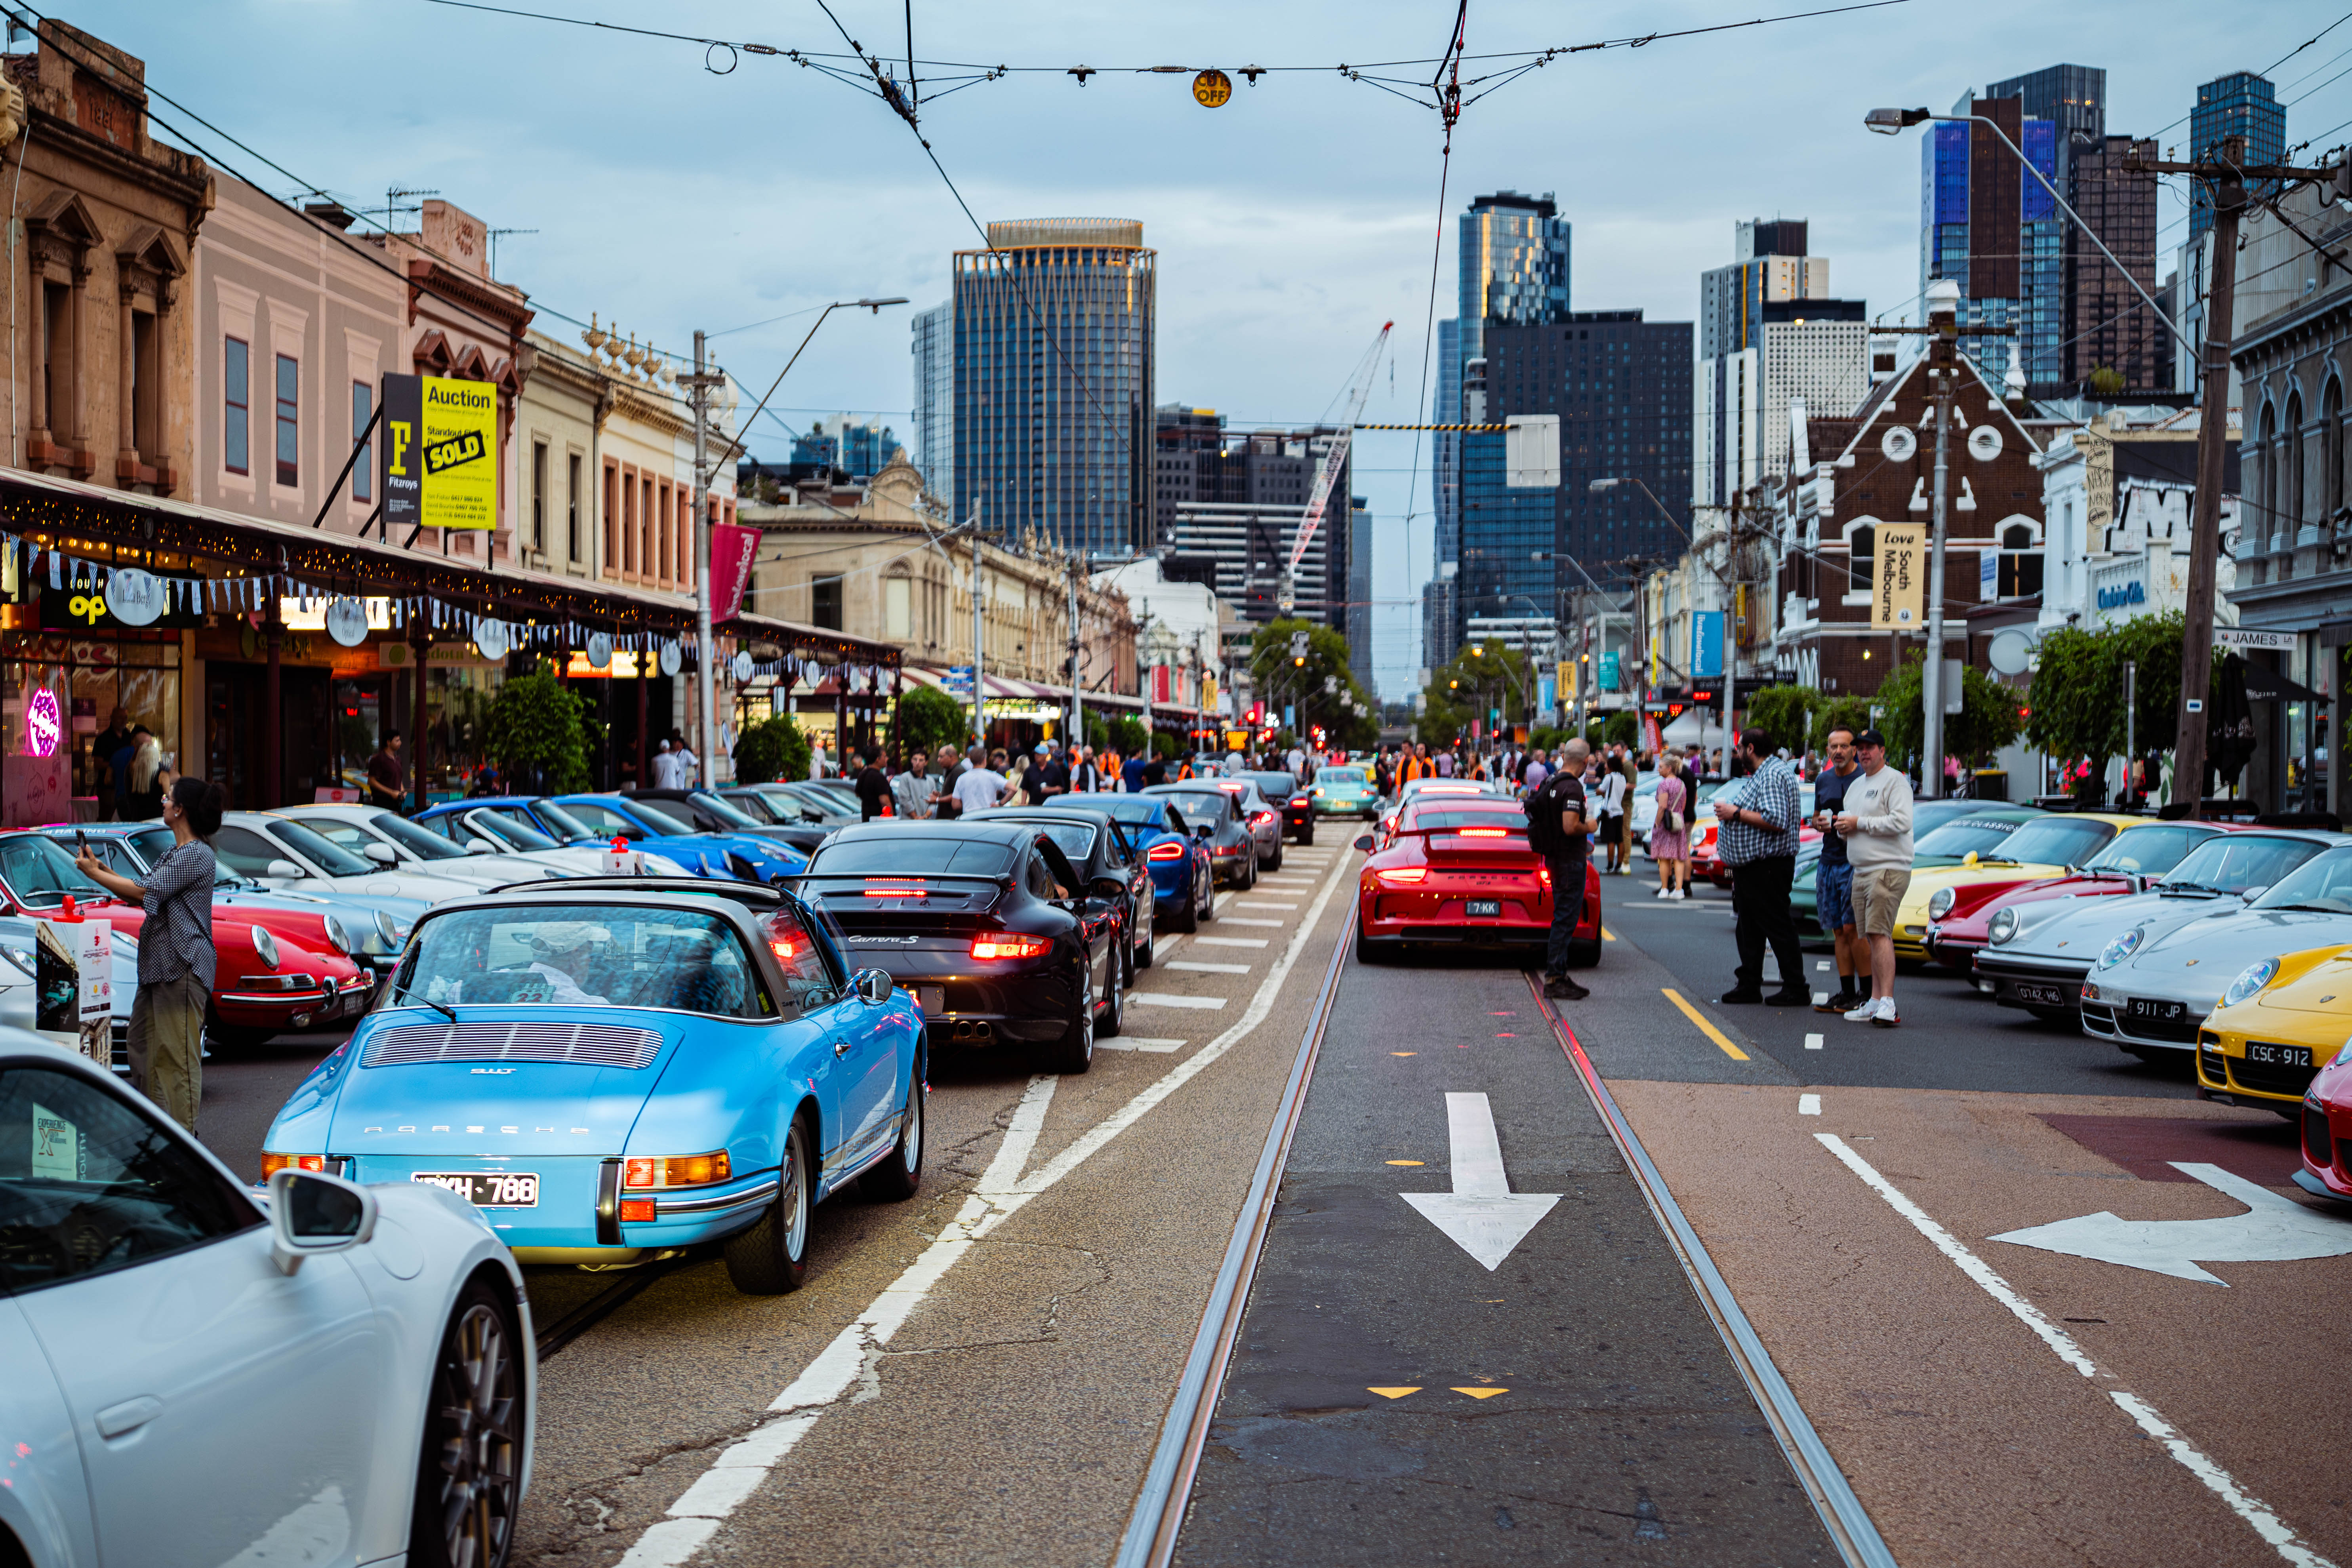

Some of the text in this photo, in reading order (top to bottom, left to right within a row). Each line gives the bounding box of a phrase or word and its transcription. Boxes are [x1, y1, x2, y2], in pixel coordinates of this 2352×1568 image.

[1197, 74, 1225, 86] CUT
[1197, 90, 1225, 102] OFF
[428, 386, 490, 408] Auction
[430, 436, 479, 469] SOLD
[389, 476, 417, 491] Fitzroys
[1885, 531, 1914, 544] Love
[1899, 550, 1912, 591] South
[70, 579, 103, 589] OUH
[1882, 549, 1896, 623] Melbourne
[2233, 633, 2277, 646] JAMES
[38, 1118, 66, 1130] EXPERIENCE
[364, 1126, 589, 1134] PORSCHE
